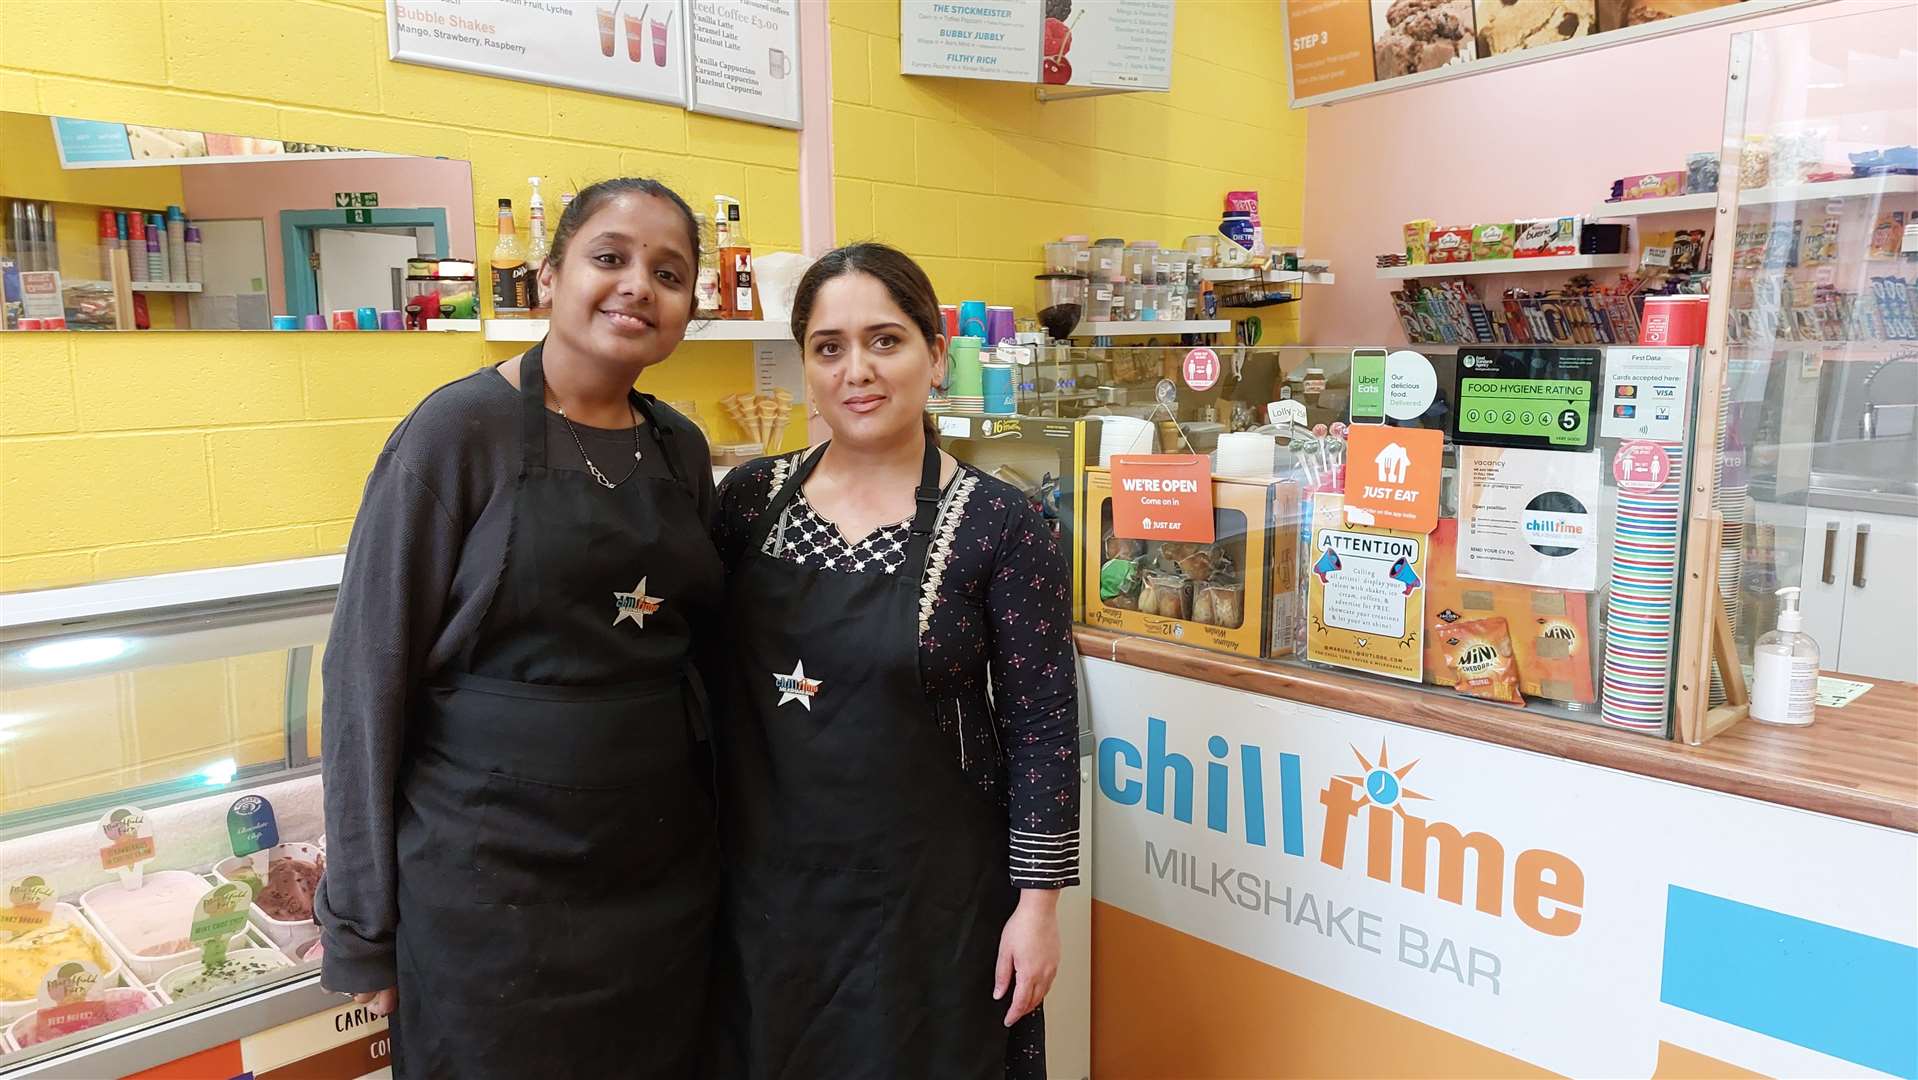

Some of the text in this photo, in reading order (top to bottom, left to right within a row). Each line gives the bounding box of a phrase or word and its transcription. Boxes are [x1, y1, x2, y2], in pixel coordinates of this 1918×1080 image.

[717, 6, 749, 24] Coffee
[933, 4, 1012, 18] THE STICKMEISTER
[397, 5, 496, 35] Bubble Shakes
[717, 19, 734, 30] Latte
[397, 22, 527, 54] Mango, Strawberry, Raspberry
[694, 23, 738, 41] Caramel Latte
[939, 29, 1006, 41] BUBBLY JUBBLY
[724, 40, 741, 51] Latte
[1293, 31, 1328, 52] STEP 3
[946, 53, 998, 65] FILTHY RICH
[696, 66, 723, 78] Caramel
[696, 76, 726, 89] Hazelnut
[1525, 229, 1551, 241] bueno
[1358, 375, 1380, 384] Uber
[1391, 373, 1404, 381] Our
[1632, 375, 1663, 383] accepted
[1358, 384, 1379, 393] Eats
[1468, 383, 1584, 396] FOOD HYGIENE RATING
[1656, 389, 1674, 397] VISA
[1272, 407, 1292, 418] Lolly
[1562, 411, 1575, 429] 5
[993, 421, 1003, 433] 16
[1122, 478, 1198, 493] WE'RE OPEN
[1362, 485, 1419, 503] JUST EAT
[1140, 496, 1162, 506] Come
[1172, 498, 1180, 506] in
[1153, 520, 1181, 530] JUST EAT
[1526, 519, 1583, 534] chilltime
[1322, 534, 1413, 558] ATTENTION
[1353, 568, 1376, 578] Calling
[1331, 582, 1349, 590] talent
[1363, 578, 1385, 589] display
[1356, 610, 1371, 619] your
[1162, 624, 1172, 636] 12
[1213, 637, 1239, 651] Autumn
[1098, 716, 1586, 938] chilltime
[1143, 840, 1503, 996] MILKSHAKE BAR
